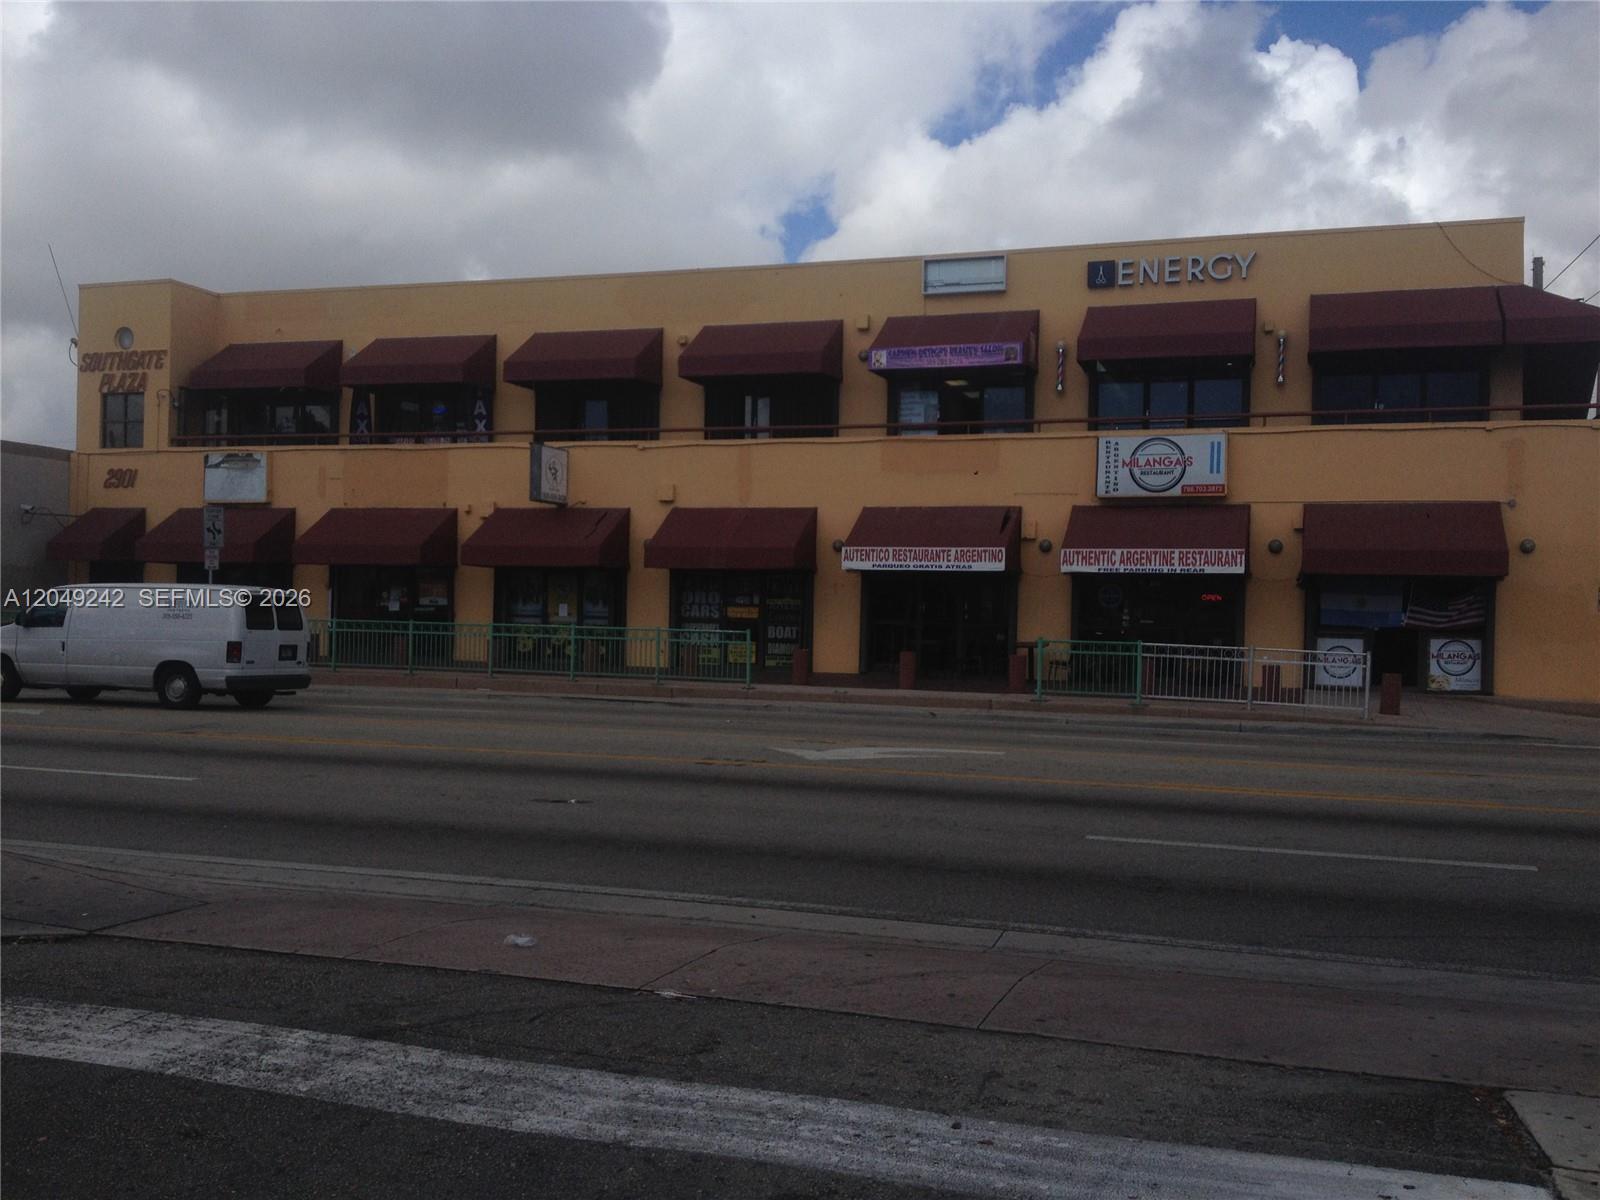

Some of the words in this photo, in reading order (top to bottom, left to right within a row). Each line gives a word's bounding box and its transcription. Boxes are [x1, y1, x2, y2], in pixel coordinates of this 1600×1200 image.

[1118, 250, 1257, 286] ENERGY
[80, 350, 168, 372] SOUTHGATE
[99, 372, 148, 392] PLAZA
[103, 468, 139, 489] 2901
[843, 548, 890, 563] AUTENTICO
[892, 548, 951, 563] RESTAURANTE
[954, 548, 1004, 563] ARGENTINO
[1062, 550, 1117, 567] AUTHENTIC
[1119, 550, 1175, 567] ARGENTINE
[1178, 550, 1245, 568] RESTAURANT
[1201, 593, 1224, 601] OPEN
